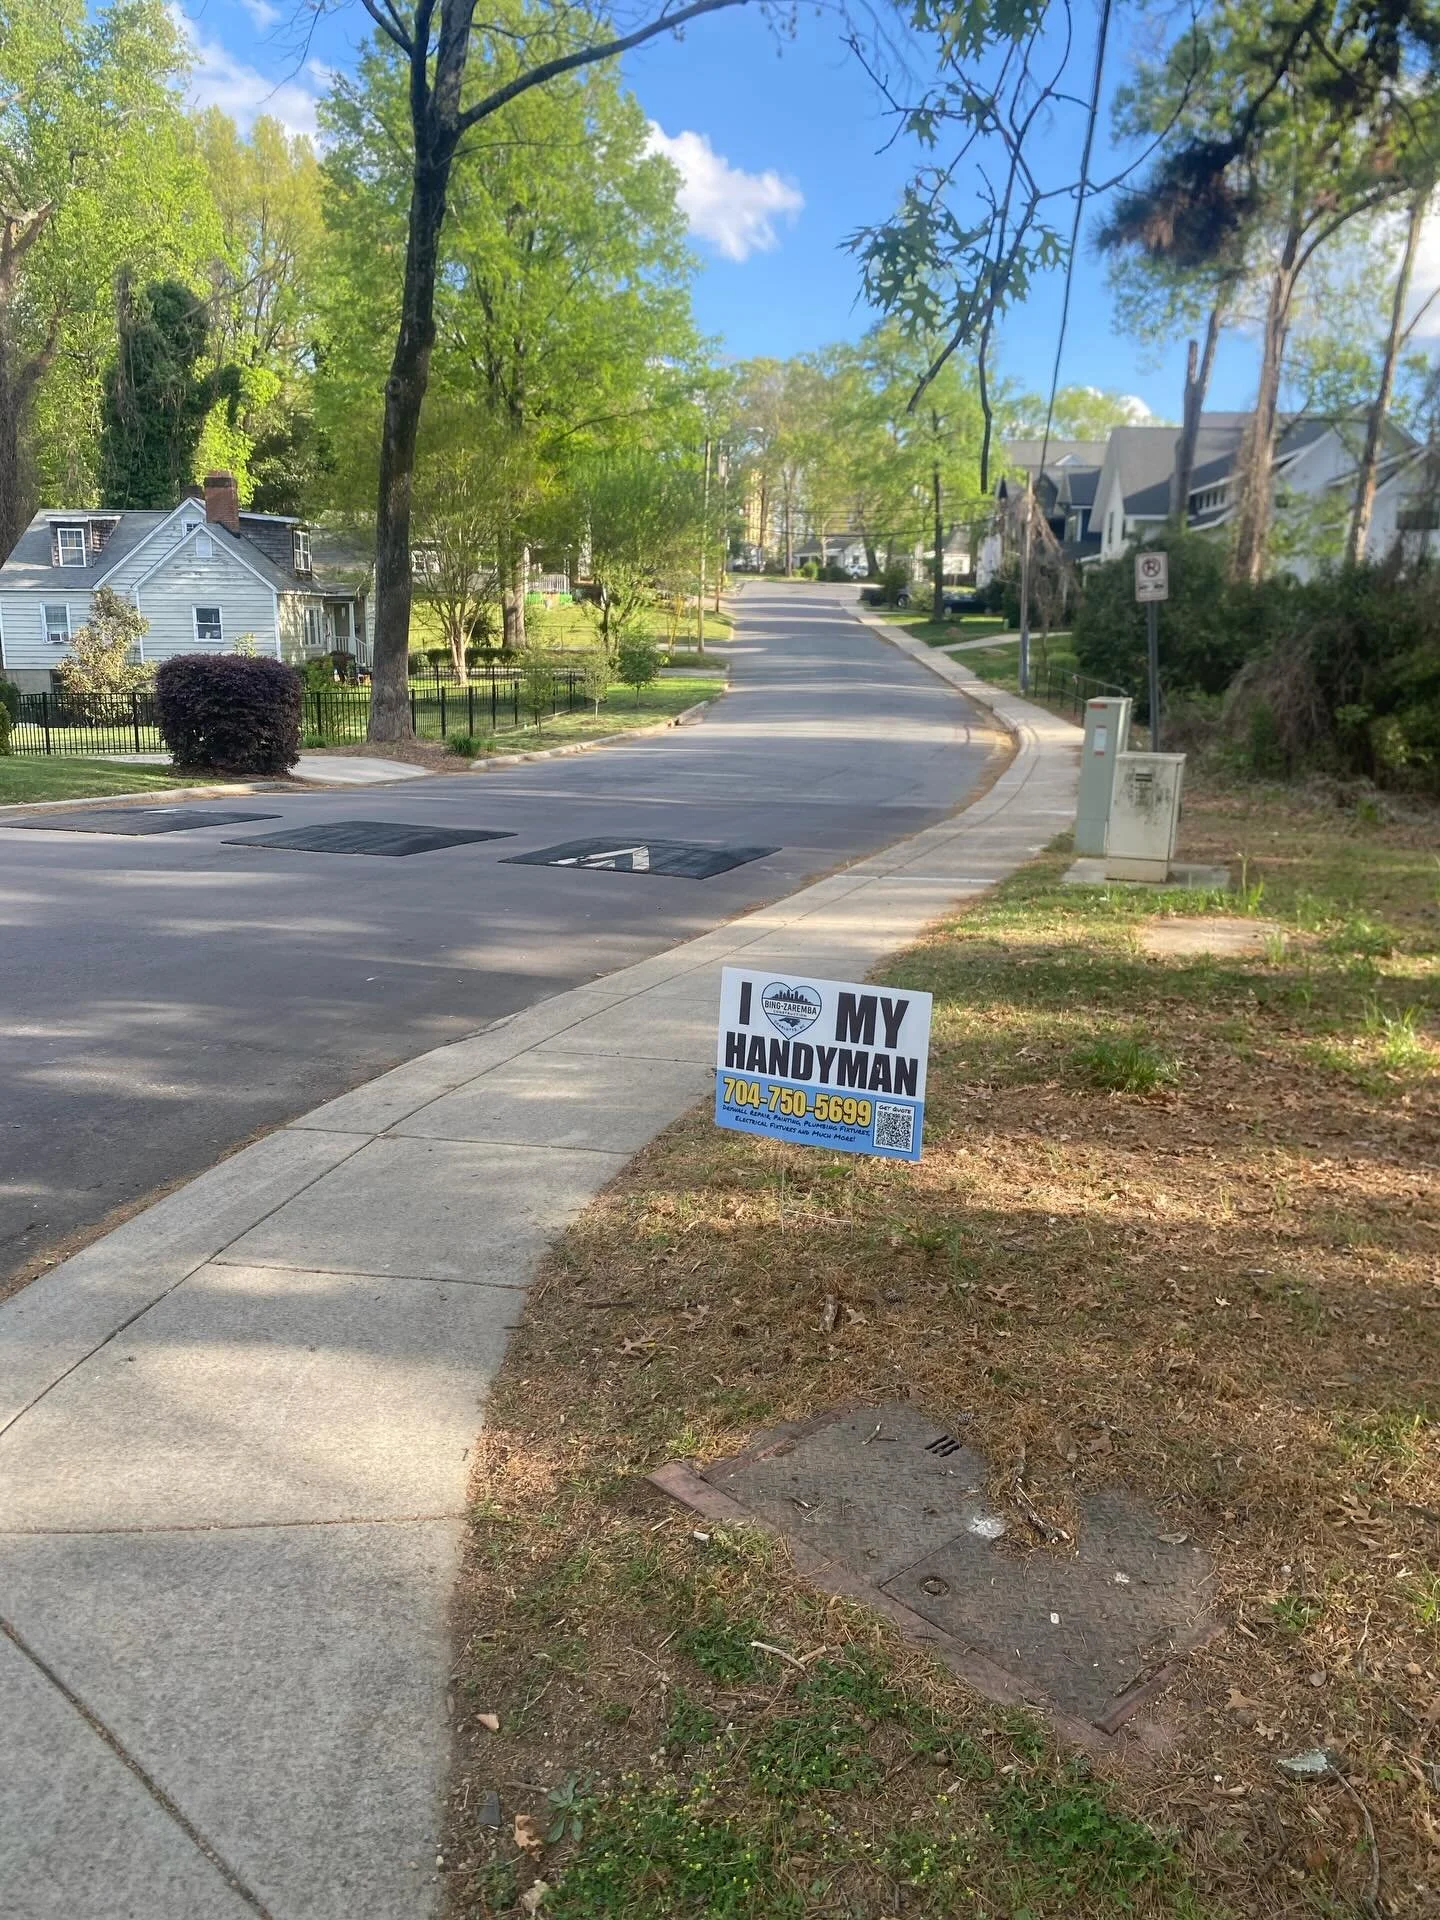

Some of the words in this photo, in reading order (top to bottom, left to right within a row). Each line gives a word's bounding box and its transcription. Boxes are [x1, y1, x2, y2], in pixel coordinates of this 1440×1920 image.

[739, 981, 752, 1025] I
[835, 991, 910, 1049] MY
[765, 1000, 817, 1015] BING-ZAREMBA
[725, 1031, 918, 1097] HANDYMAN
[723, 1077, 872, 1128] 704-750-5699
[892, 1106, 912, 1114] QUOTE
[735, 1115, 767, 1128] ELECTRICAL
[769, 1122, 797, 1134] FIXTURES
[812, 1130, 832, 1139] MUCH
[833, 1134, 856, 1142] MORE!
[804, 1120, 838, 1131] PLUMBING
